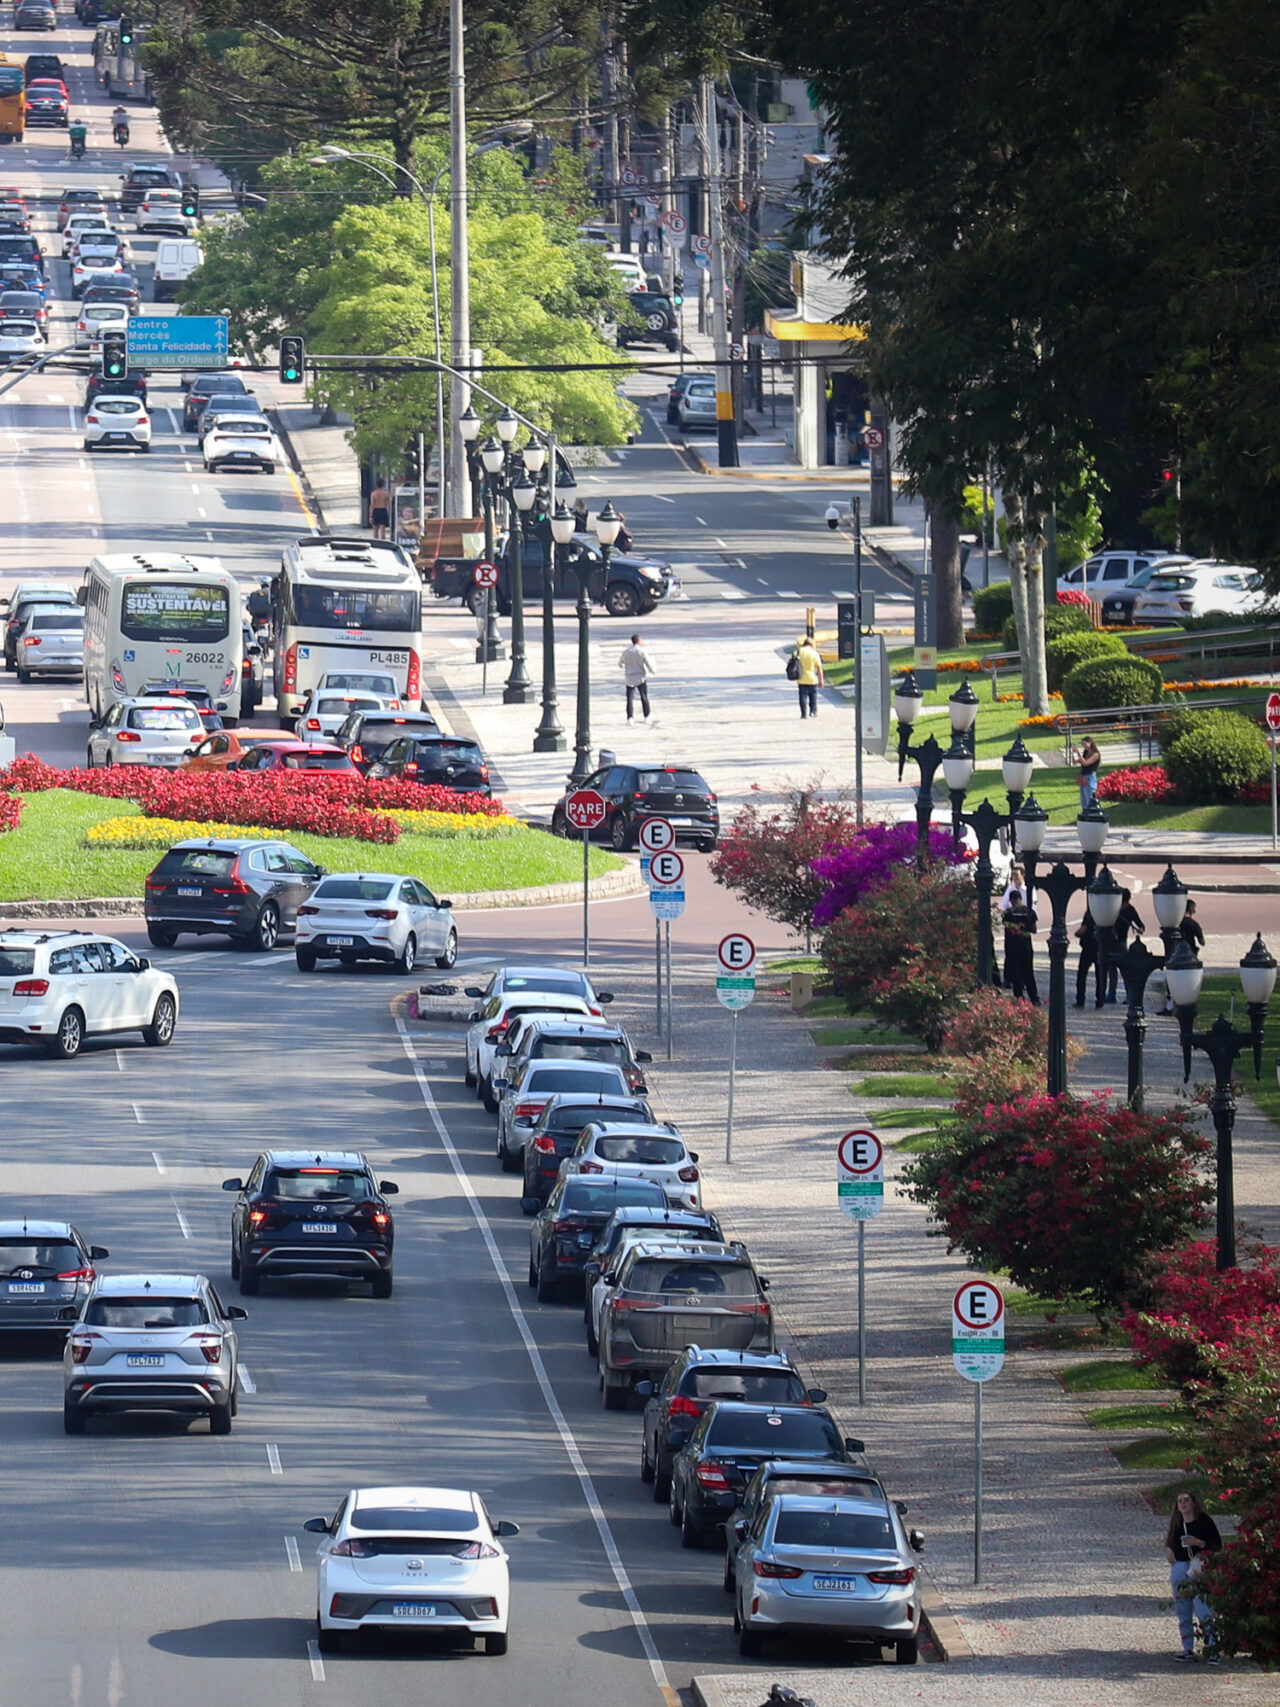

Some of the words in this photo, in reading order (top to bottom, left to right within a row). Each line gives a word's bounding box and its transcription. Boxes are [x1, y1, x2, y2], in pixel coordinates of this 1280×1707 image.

[128, 320, 168, 329] Centro
[128, 342, 158, 351] Santa
[162, 342, 212, 351] Felicidade
[128, 355, 159, 365] Largo
[162, 355, 175, 364] da
[177, 355, 213, 364] Ordem
[126, 598, 227, 611] SUSTENTÁVEL
[186, 653, 224, 663] 26022
[370, 652, 408, 664] PL485
[165, 662, 181, 676] M
[569, 803, 602, 814] PARE
[651, 826, 663, 844] E
[661, 858, 672, 876] E
[730, 942, 743, 962] E
[853, 1140, 868, 1164] E
[970, 1292, 986, 1318] E
